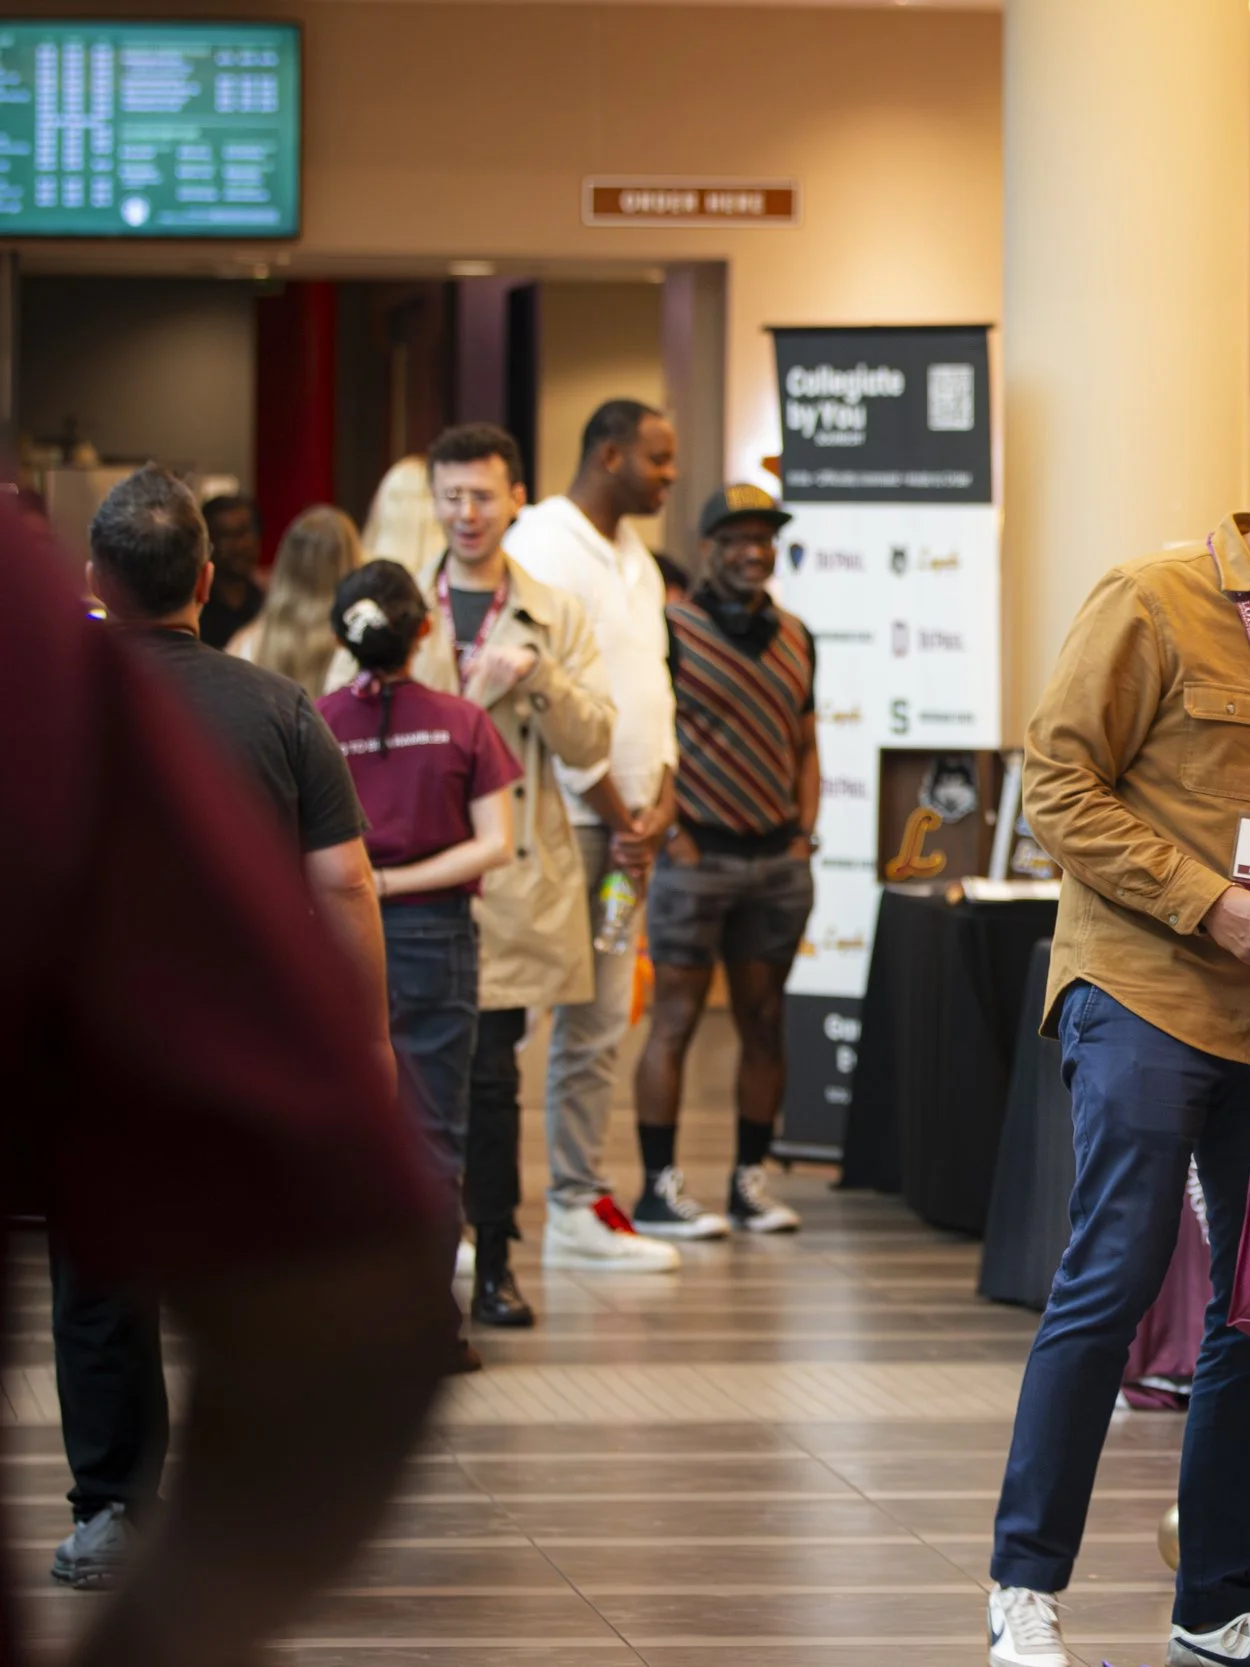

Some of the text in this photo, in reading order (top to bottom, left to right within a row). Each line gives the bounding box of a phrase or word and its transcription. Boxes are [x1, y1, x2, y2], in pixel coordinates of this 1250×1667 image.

[619, 189, 765, 215] ORDER HERE
[786, 363, 905, 405] Collegiate
[820, 401, 867, 432] You
